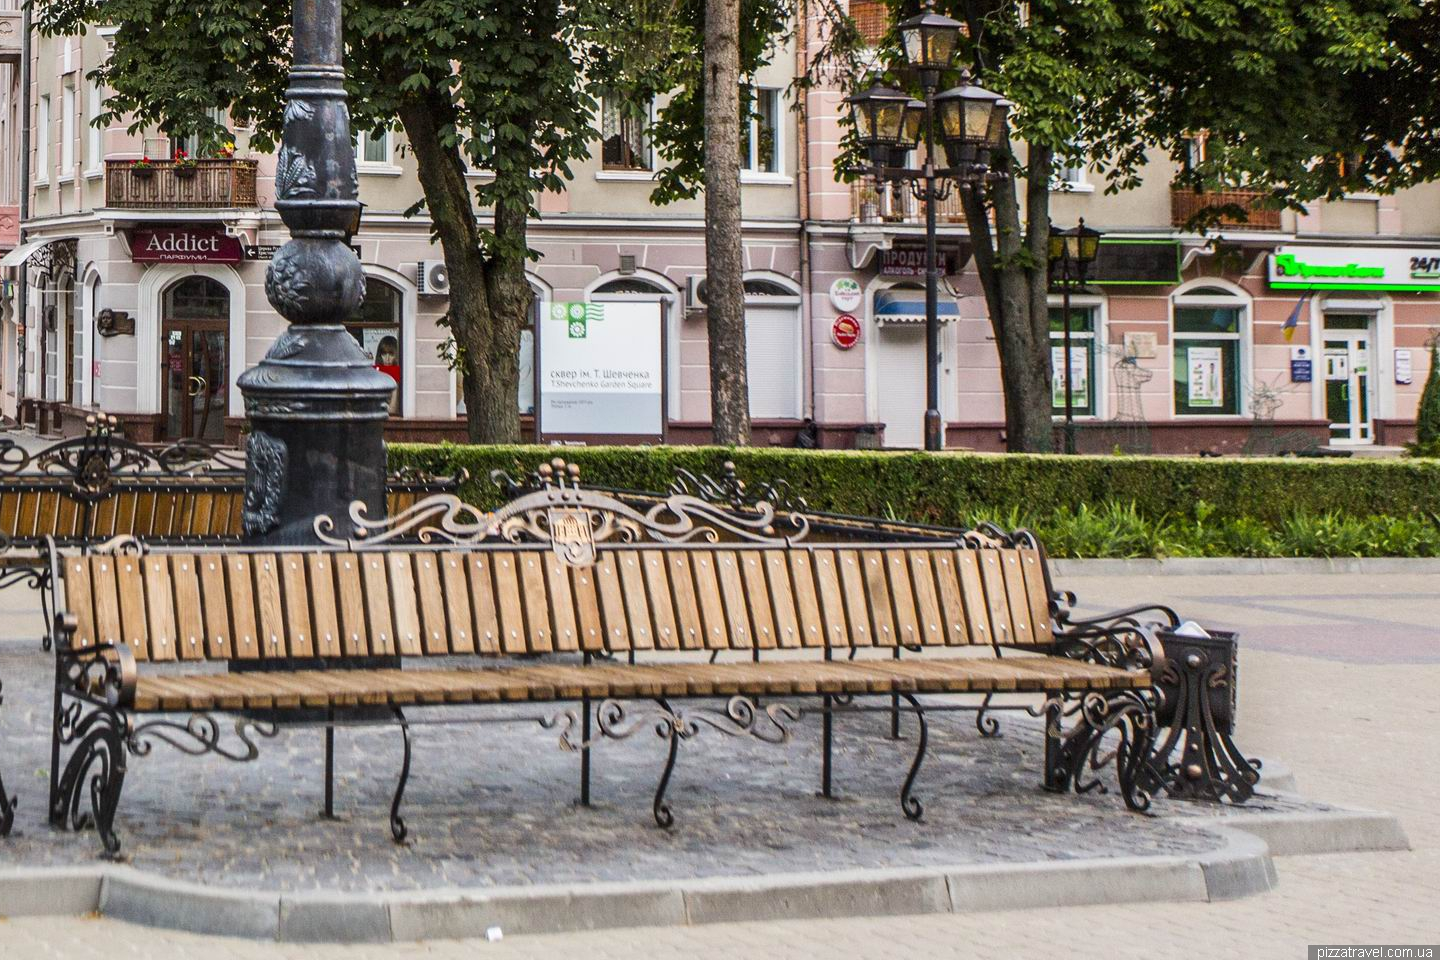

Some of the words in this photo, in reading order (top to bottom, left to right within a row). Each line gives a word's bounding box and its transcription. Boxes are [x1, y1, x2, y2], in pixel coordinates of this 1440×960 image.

[146, 233, 220, 252] Addict
[550, 370, 577, 379] сквер
[603, 369, 650, 379] Шевченка
